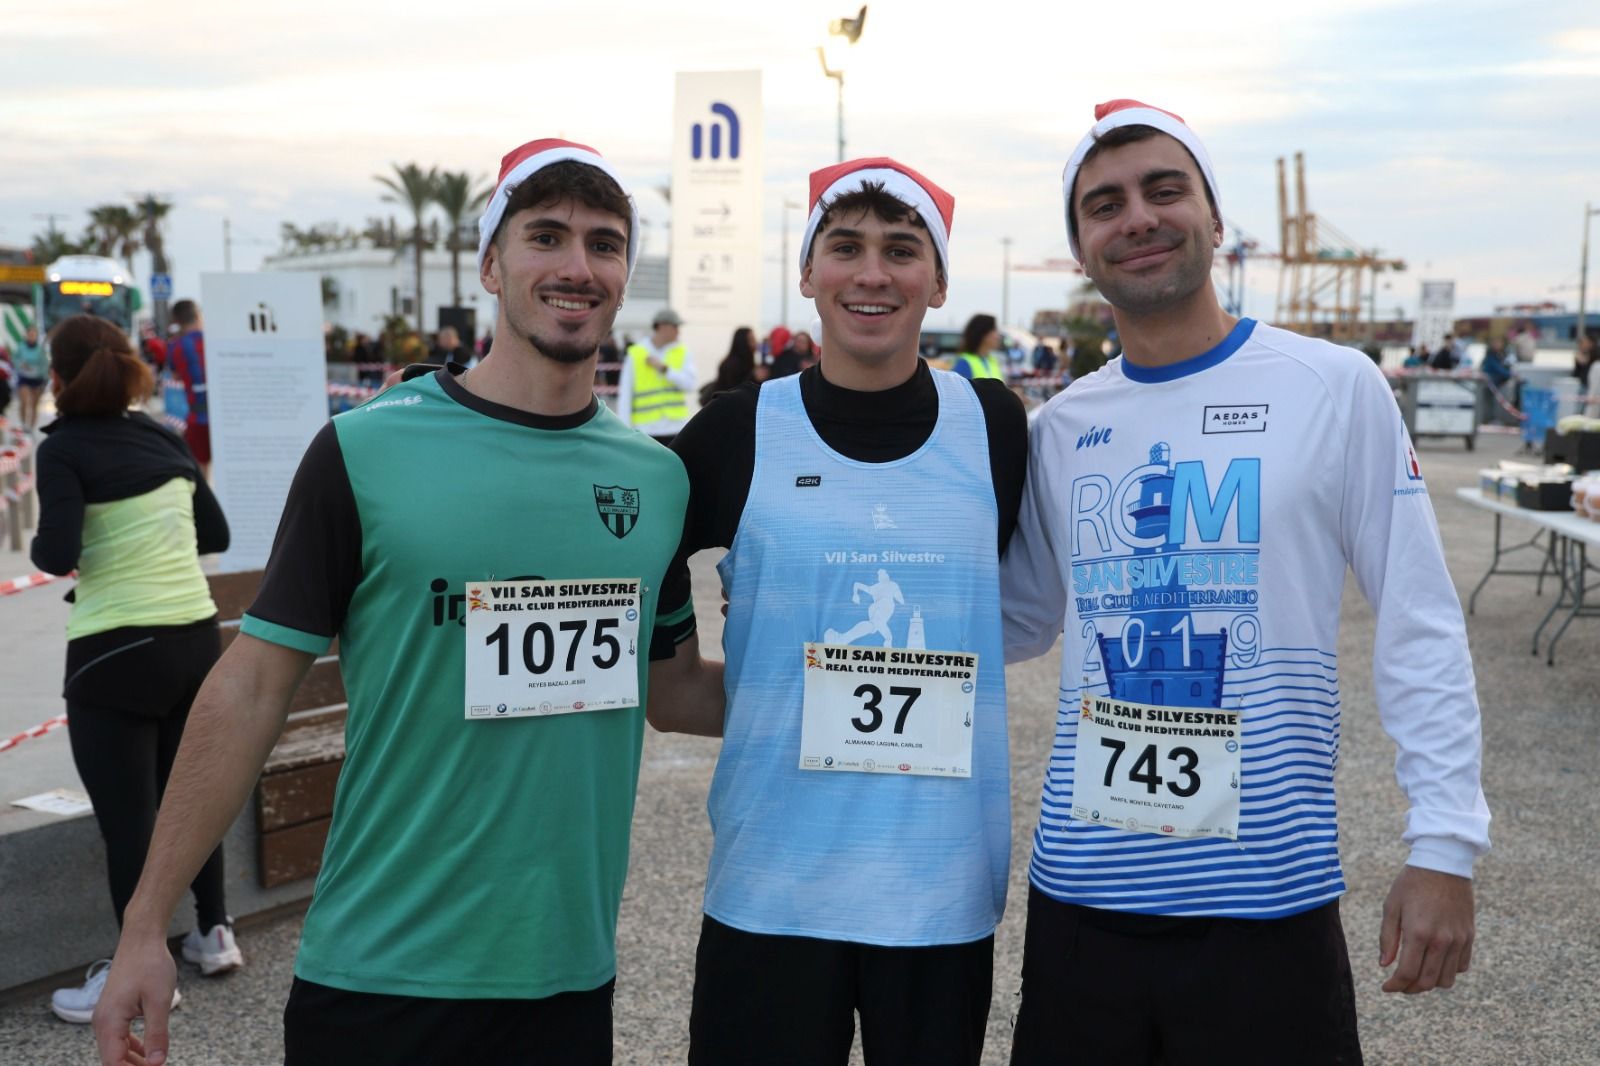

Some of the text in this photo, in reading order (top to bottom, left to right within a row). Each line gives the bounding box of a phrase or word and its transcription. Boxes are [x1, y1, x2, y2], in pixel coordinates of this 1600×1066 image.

[1213, 412, 1259, 421] AEDAS
[1071, 458, 1260, 556] RCM
[825, 551, 945, 563] VII San Silvestre
[1072, 554, 1258, 594] SAN SILVESTRE
[491, 583, 637, 599] VII SAN SILVESTRE
[494, 602, 524, 612] REAL
[527, 601, 555, 610] CLUB
[486, 618, 621, 676] 1075
[824, 648, 975, 667] VII SAN SILVESTRE
[826, 664, 854, 672] REAL
[856, 665, 885, 674] CLUB
[851, 684, 921, 734] 37
[1095, 700, 1237, 725] VII SAN SILVESTRE
[1095, 717, 1115, 728] REAL
[1118, 722, 1141, 732] CLUB
[1100, 737, 1201, 798] 743
